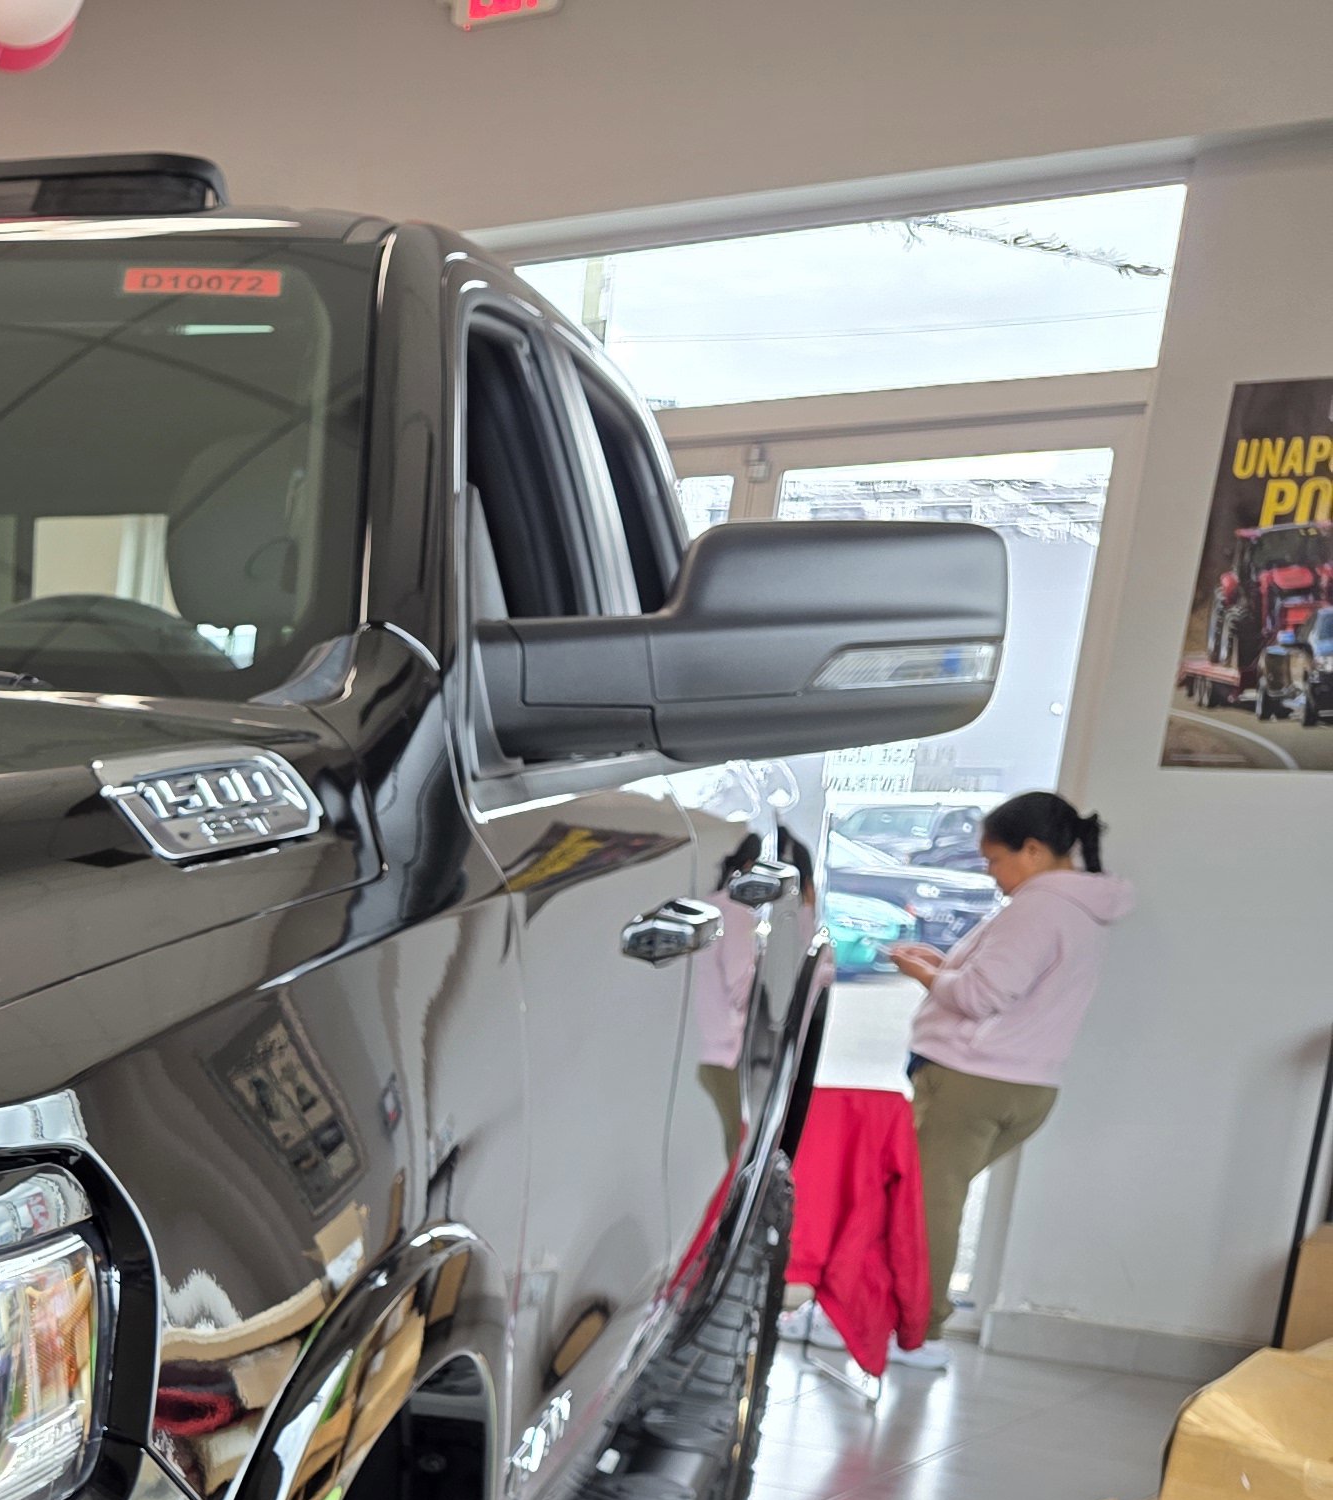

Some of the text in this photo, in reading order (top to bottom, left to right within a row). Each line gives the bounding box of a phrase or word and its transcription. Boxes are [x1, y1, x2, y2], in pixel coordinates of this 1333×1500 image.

[141, 273, 263, 292] D10072
[1233, 434, 1333, 480] UNAP
[140, 768, 273, 820] 1500
